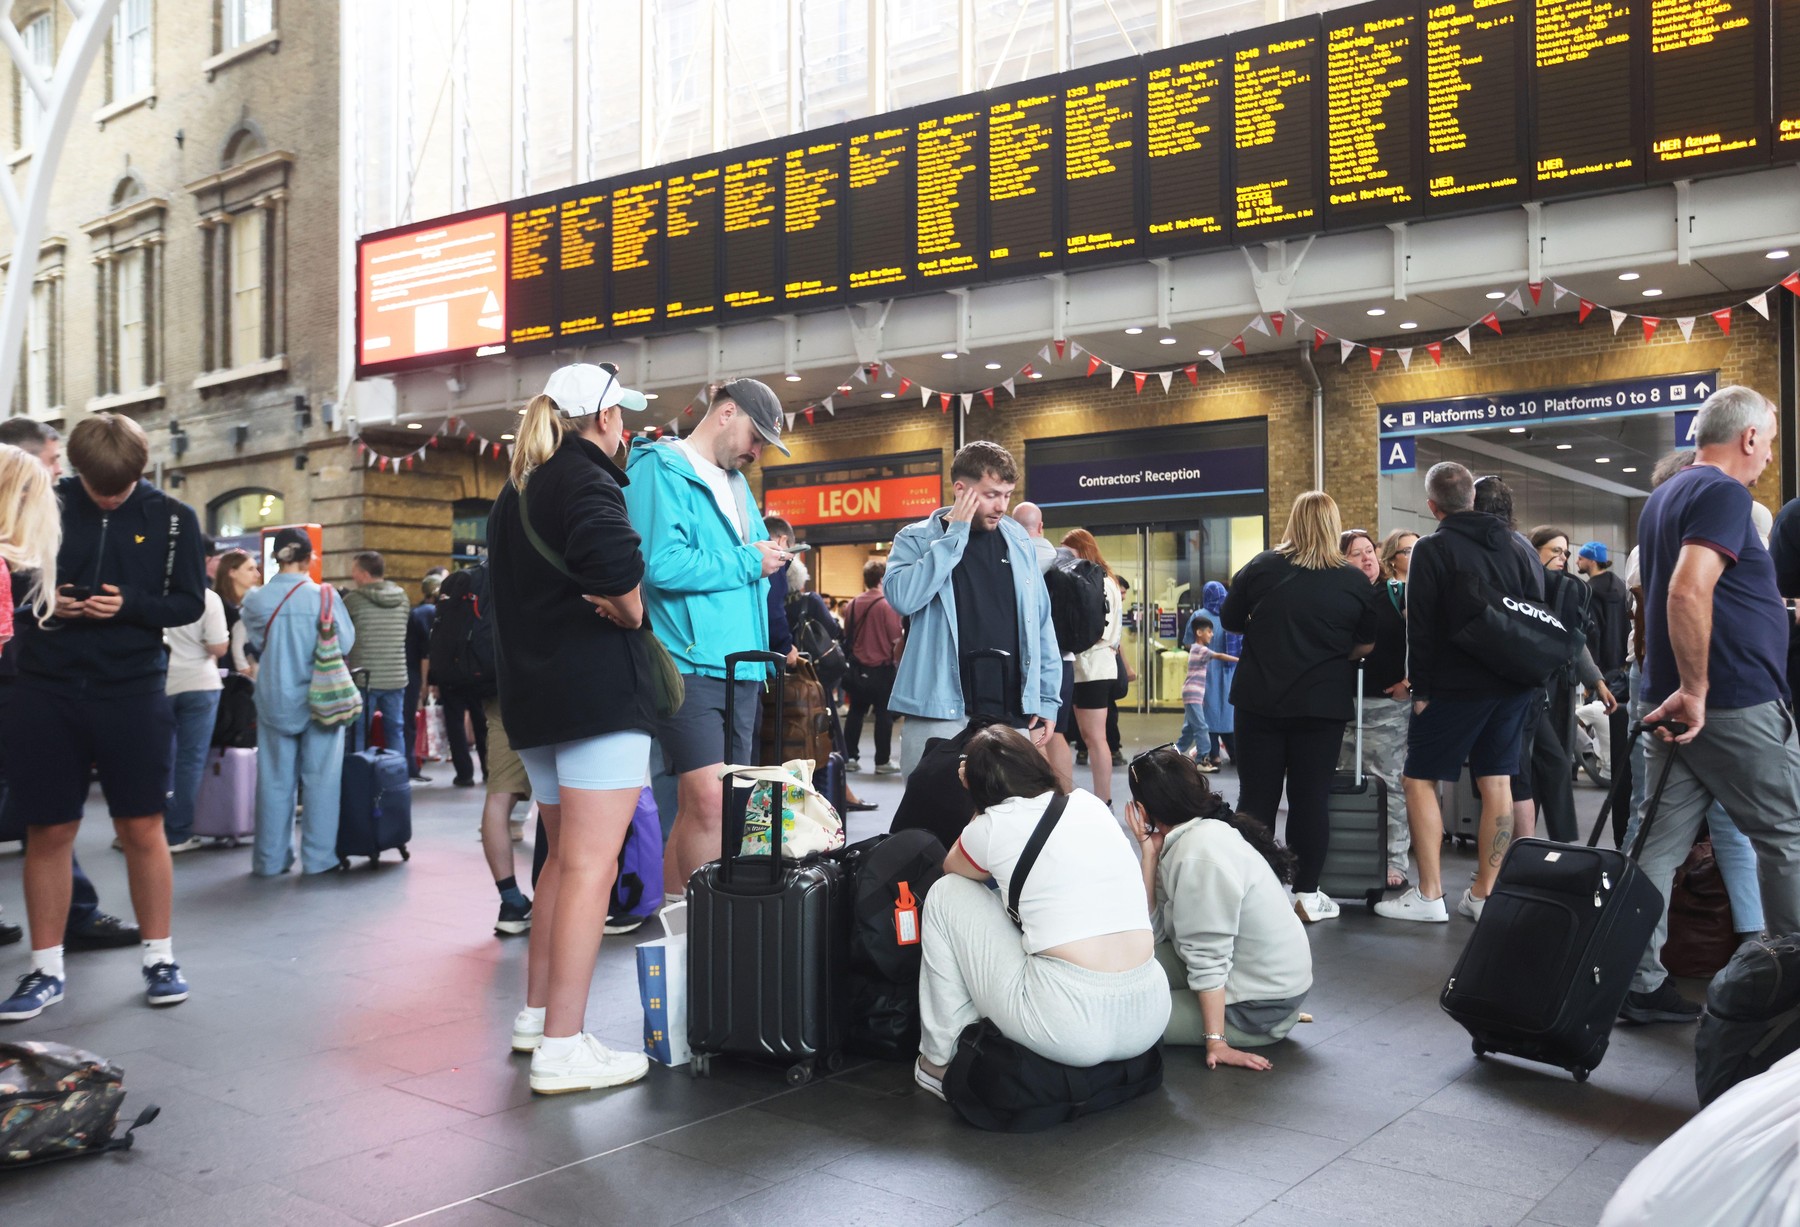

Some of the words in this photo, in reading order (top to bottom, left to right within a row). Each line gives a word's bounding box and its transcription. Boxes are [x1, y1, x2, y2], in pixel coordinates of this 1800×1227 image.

[1429, 4, 1455, 19] 14:00
[1364, 17, 1404, 33] Platform
[1428, 14, 1474, 32] Aberdeen
[1654, 138, 1681, 153] LNER
[1538, 158, 1563, 171] LNER
[1430, 176, 1454, 189] LNER
[1430, 186, 1465, 197] orecasted
[1330, 192, 1357, 204] Great
[1360, 186, 1404, 200] Northern
[1544, 394, 1612, 413] Platforms
[1616, 391, 1626, 405] 0
[1630, 390, 1646, 404] to
[1650, 388, 1660, 402] 8
[1422, 404, 1484, 424] Platforms
[1488, 404, 1497, 418] 9
[1500, 403, 1515, 416] to
[1519, 401, 1537, 415] 10
[1388, 442, 1407, 465] A
[1079, 471, 1143, 487] Contractors'
[1145, 467, 1200, 482] Reception
[818, 486, 880, 517] LEON
